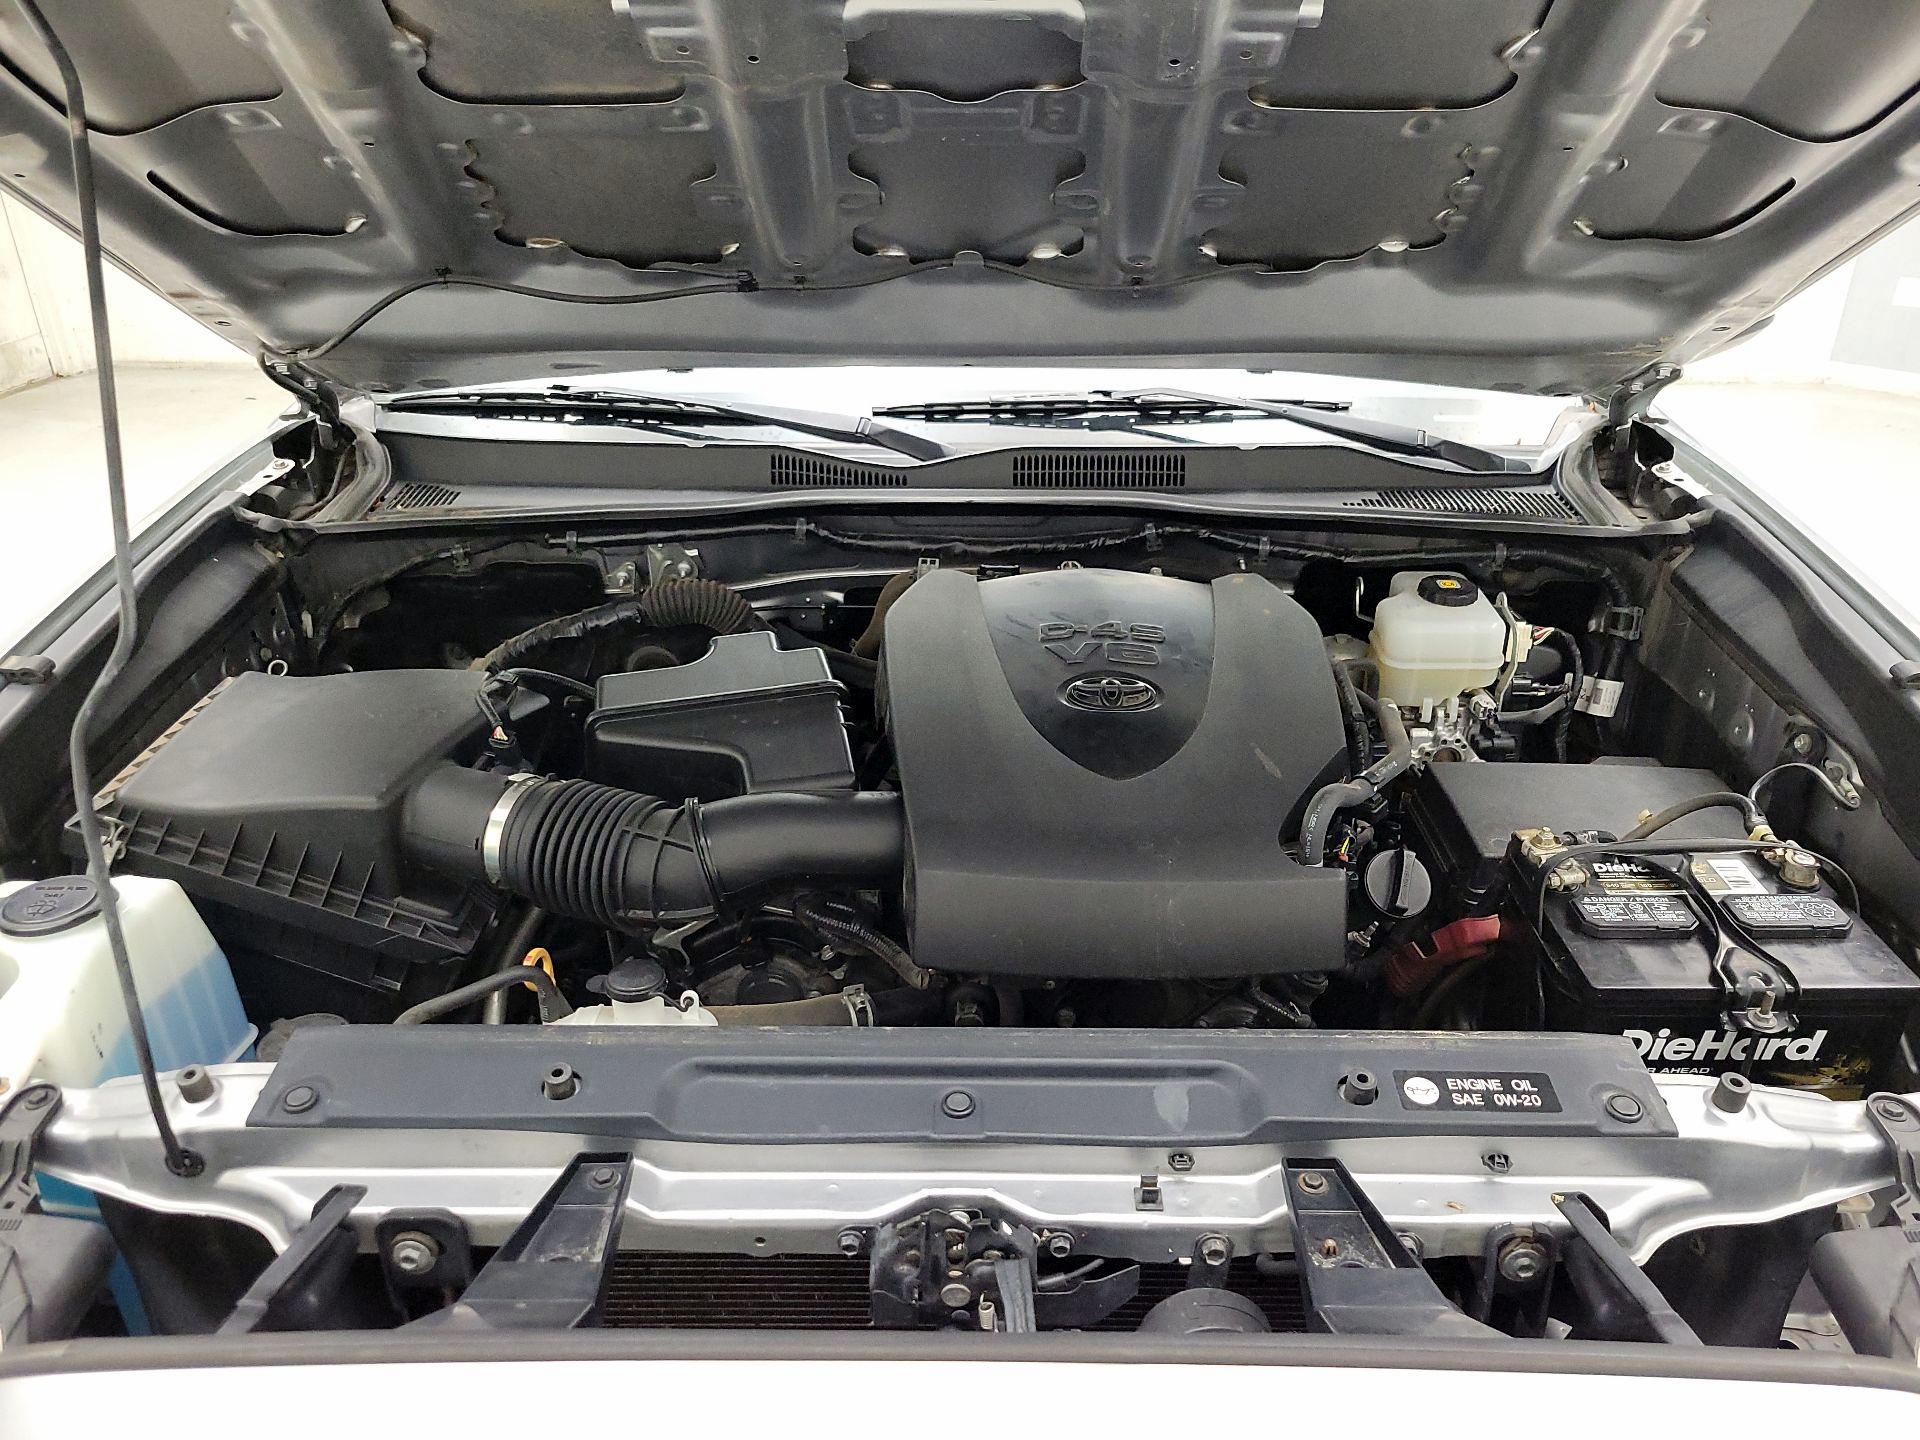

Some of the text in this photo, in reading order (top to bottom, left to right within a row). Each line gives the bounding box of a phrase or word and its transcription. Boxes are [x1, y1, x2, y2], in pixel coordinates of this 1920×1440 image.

[1044, 641, 1161, 665] V6
[1446, 1078, 1538, 1092] ENGINE OIL
[1452, 1093, 1542, 1107] SAE 0W-20
